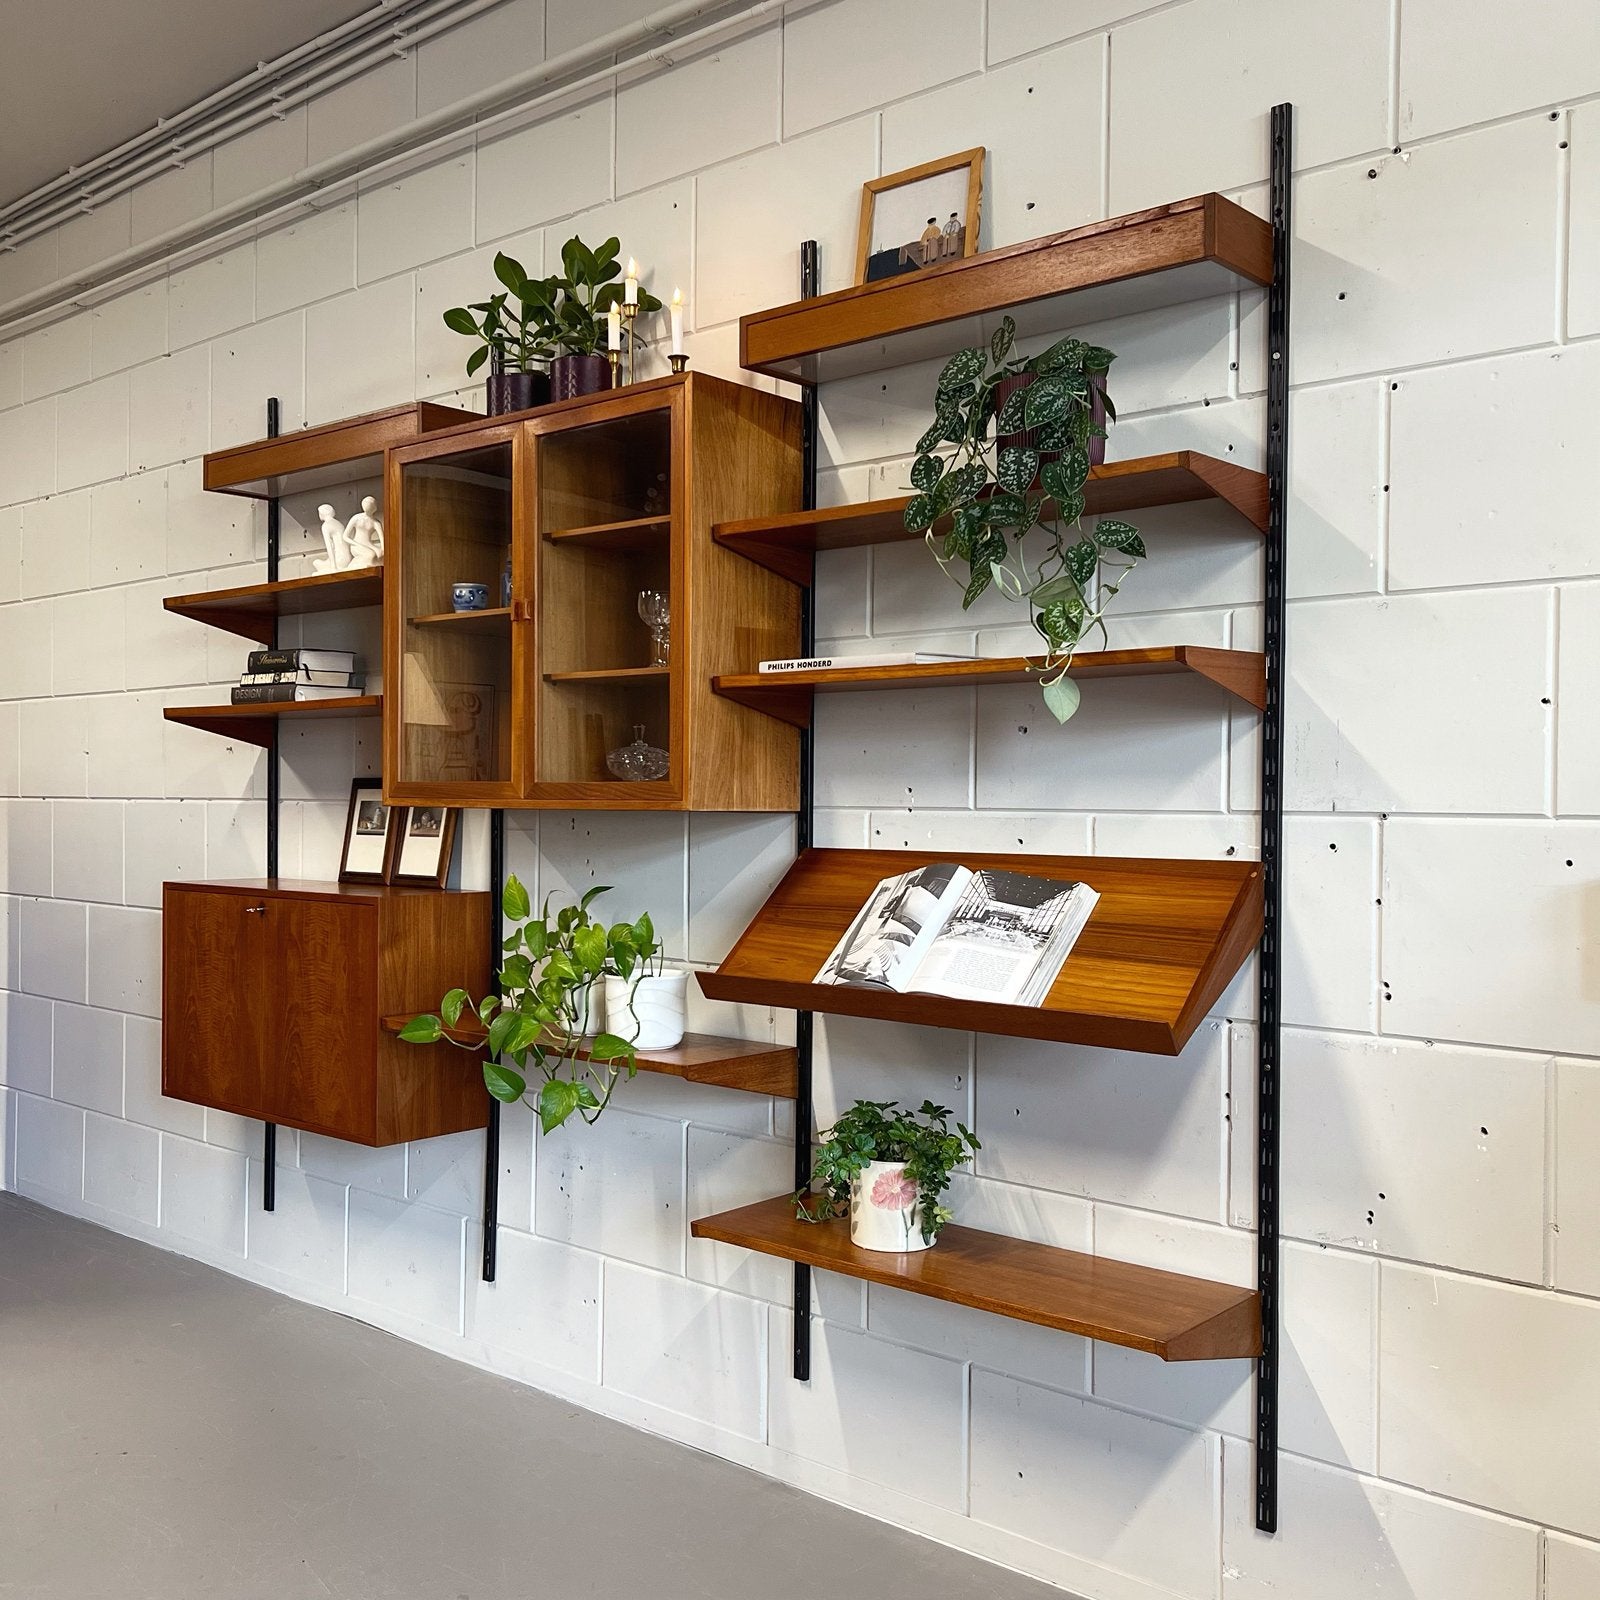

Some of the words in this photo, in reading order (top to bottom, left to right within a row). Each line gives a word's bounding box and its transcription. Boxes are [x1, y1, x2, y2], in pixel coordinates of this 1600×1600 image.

[767, 662, 794, 671] PHILIPS
[797, 660, 832, 669] HONDERD
[234, 688, 262, 699] DESIGN
